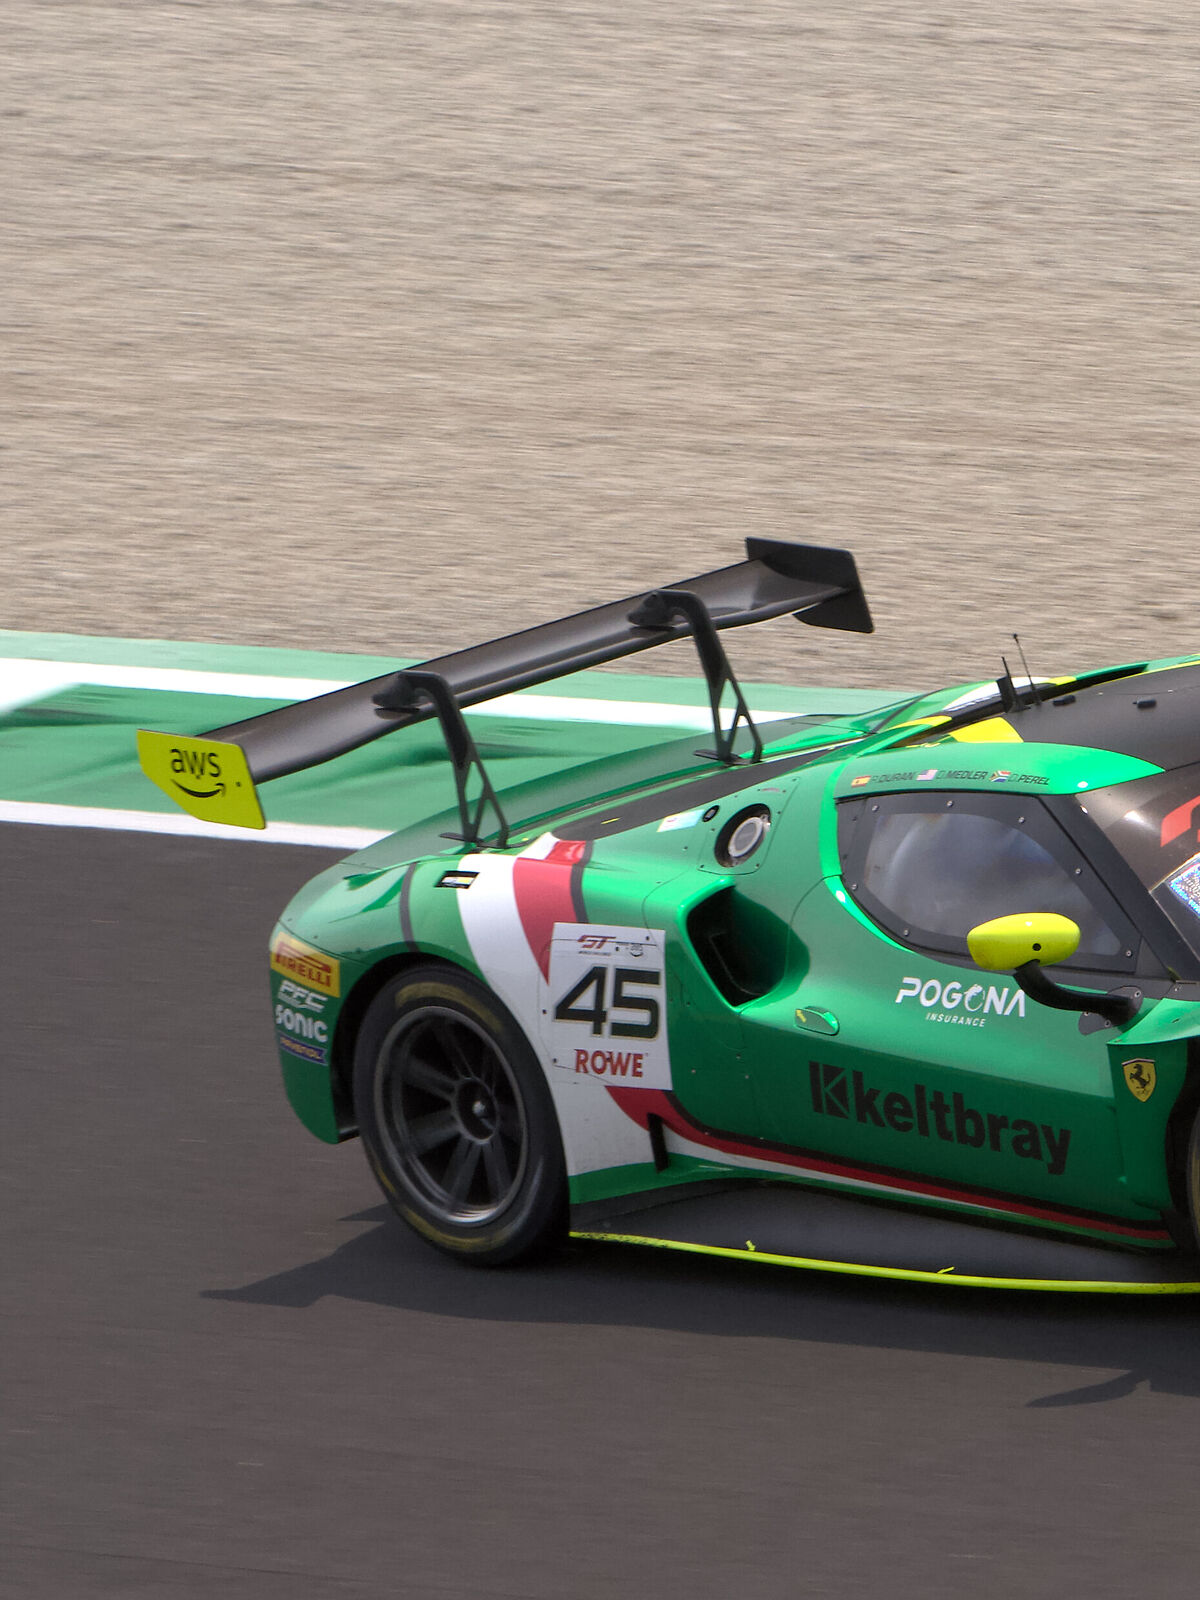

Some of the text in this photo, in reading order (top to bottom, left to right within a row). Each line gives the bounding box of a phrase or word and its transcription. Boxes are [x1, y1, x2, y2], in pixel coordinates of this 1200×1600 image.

[169, 746, 221, 779] aws
[578, 934, 617, 949] GT
[275, 941, 332, 988] PIRELLI
[554, 965, 661, 1040] 45
[925, 1012, 986, 1028] INSURANCE
[574, 1048, 644, 1078] ROWE
[852, 1070, 1072, 1175] keltbray
